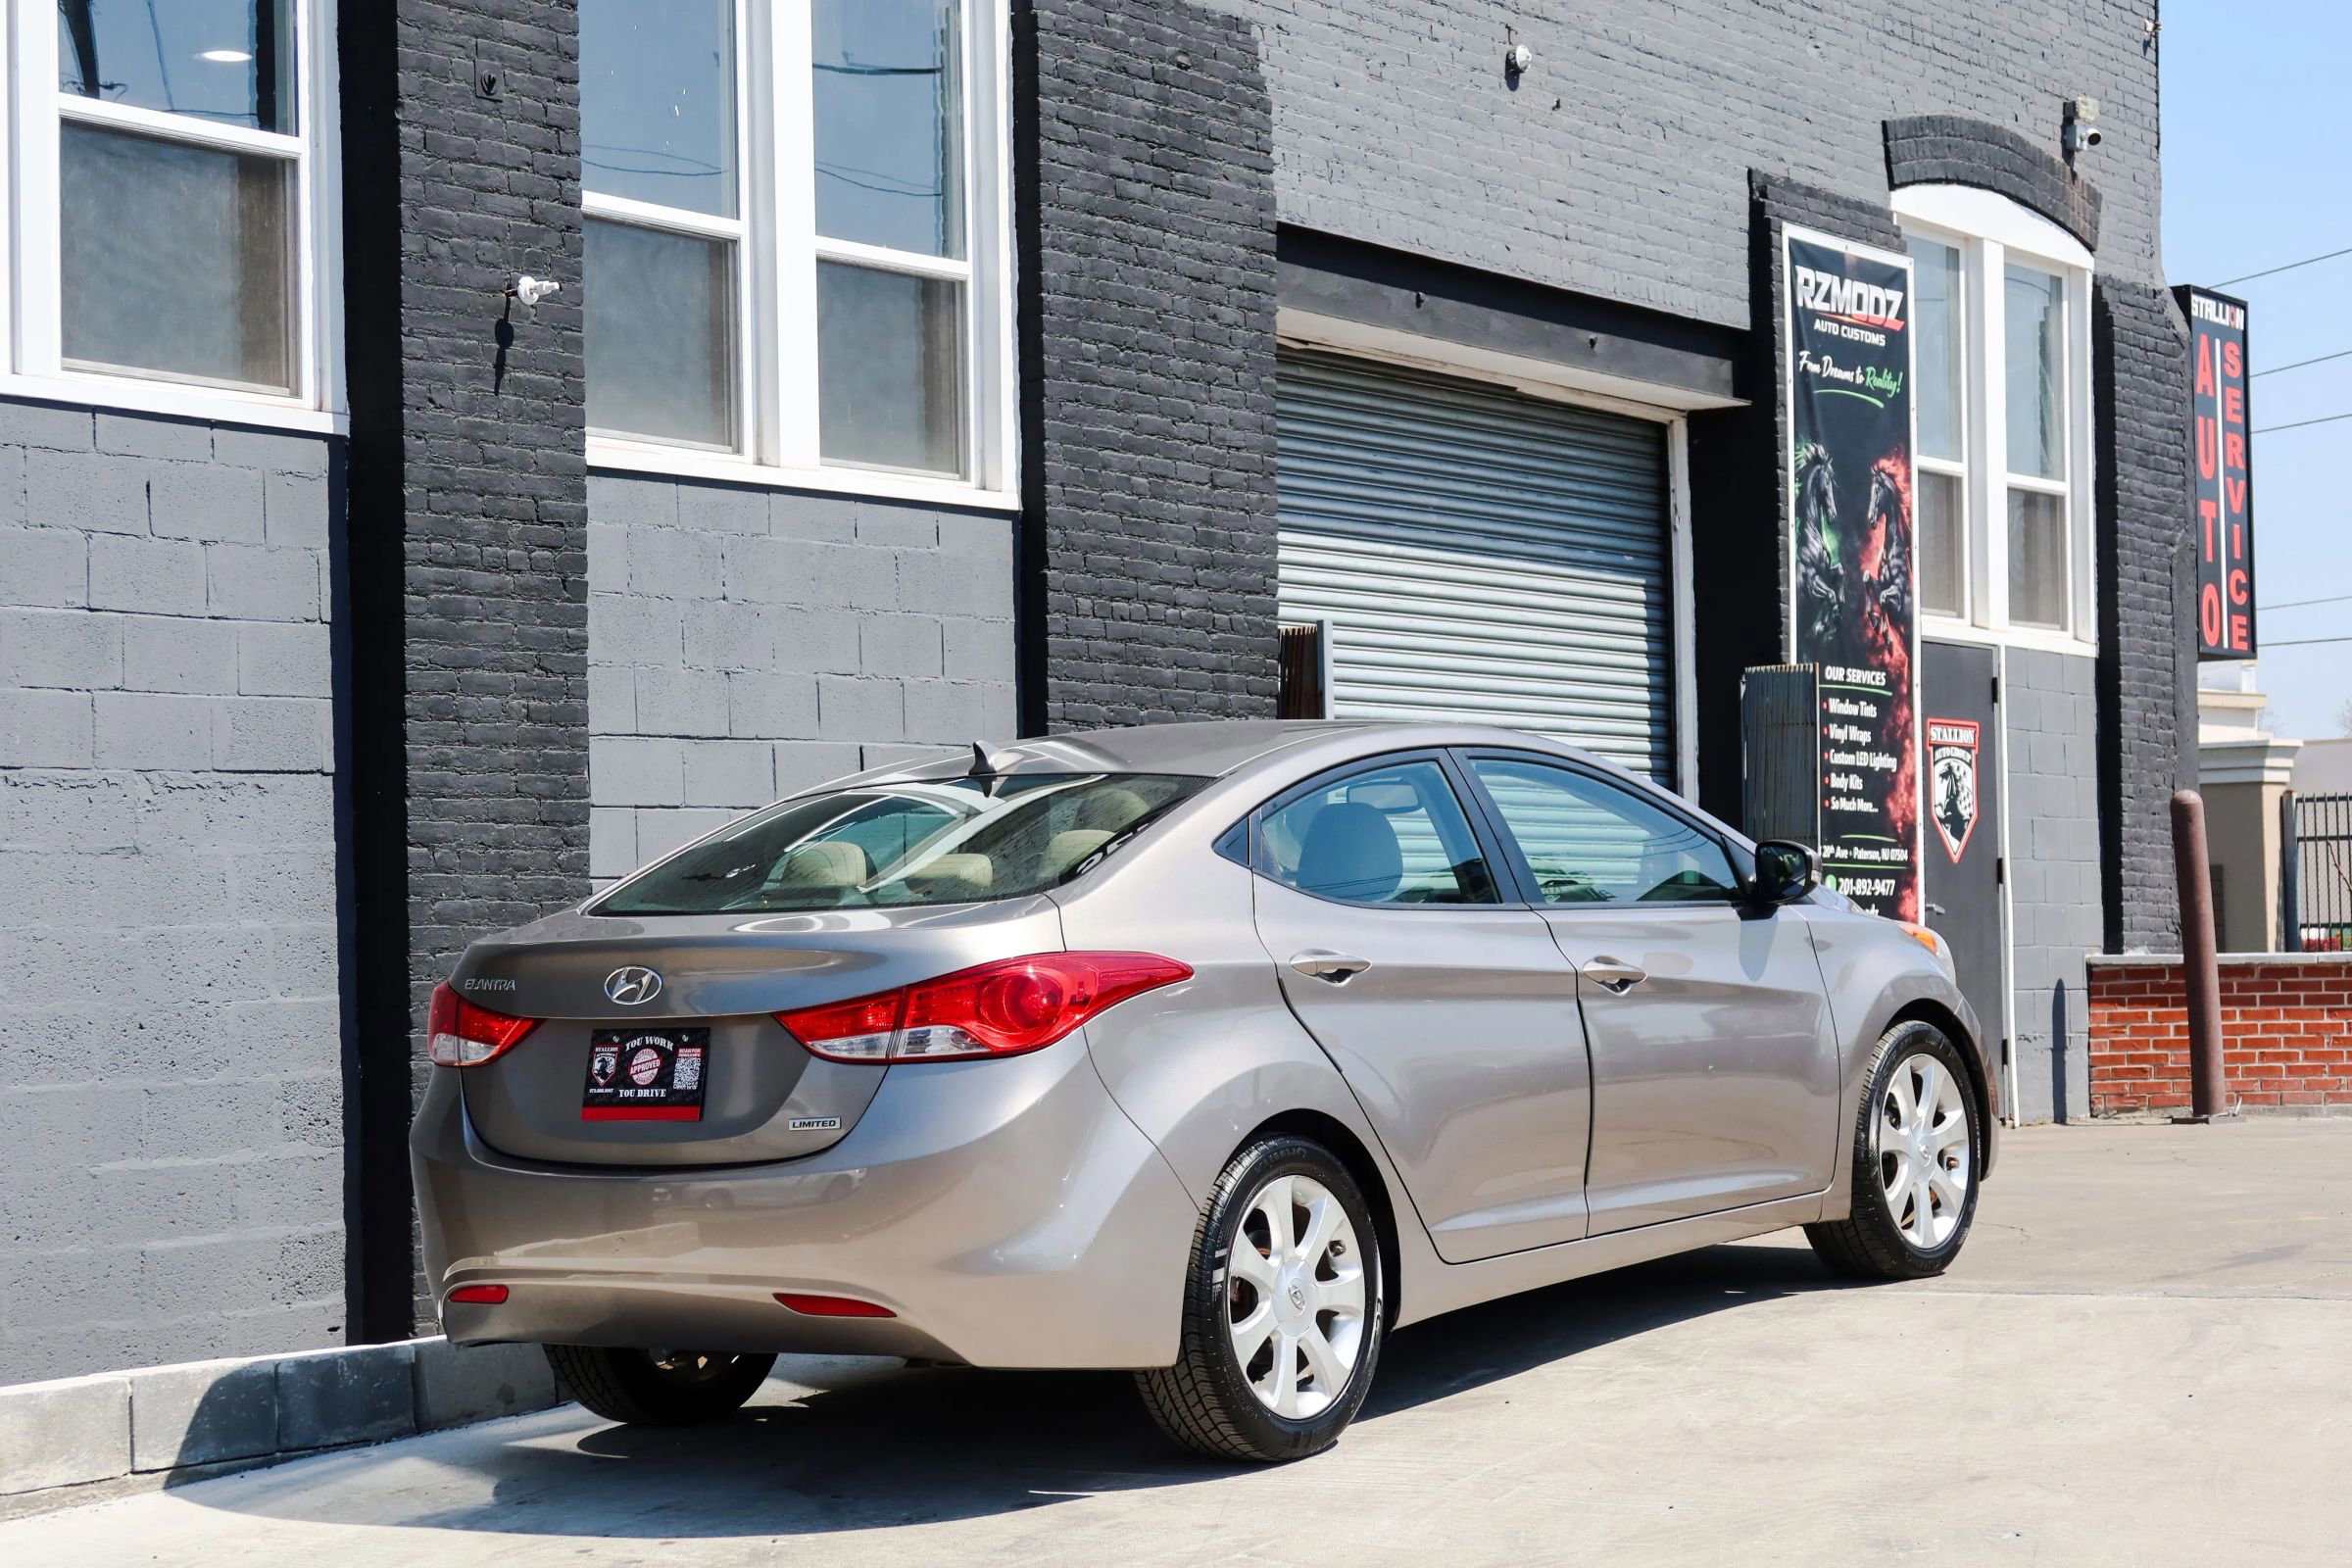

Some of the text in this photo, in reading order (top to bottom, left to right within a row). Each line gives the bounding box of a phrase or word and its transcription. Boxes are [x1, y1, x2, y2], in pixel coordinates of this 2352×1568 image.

[1795, 266, 1905, 331] RZMODZ
[2191, 294, 2244, 331] STALLION
[1814, 318, 1886, 347] AUTO CUSTOMS
[1799, 351, 1903, 398] From Dreams to Reality!
[2196, 333, 2221, 648] AUTO
[2224, 341, 2249, 651] SERVICE
[1825, 665, 1886, 686] OUR SERVICES
[1829, 698, 1877, 717] Window Tints
[1829, 723, 1872, 746] Vinyl Wraps
[1931, 726, 1975, 744] STALLION
[1830, 749, 1898, 772] Custom LED Lighting
[1831, 772, 1863, 792] Body Kits
[1831, 796, 1879, 813] So Much More...
[1835, 846, 1848, 858] Ave
[1853, 847, 1881, 861] Paterson,
[1882, 848, 1890, 860] NJ
[1838, 877, 1895, 896] 201-892-9477
[465, 979, 515, 991] ELANTRA
[625, 1036, 674, 1052] YOU WORK
[630, 1058, 661, 1075] APPROVED
[618, 1089, 636, 1098] YOU
[636, 1089, 666, 1098] DRIVE
[792, 1119, 837, 1129] LIMITED
